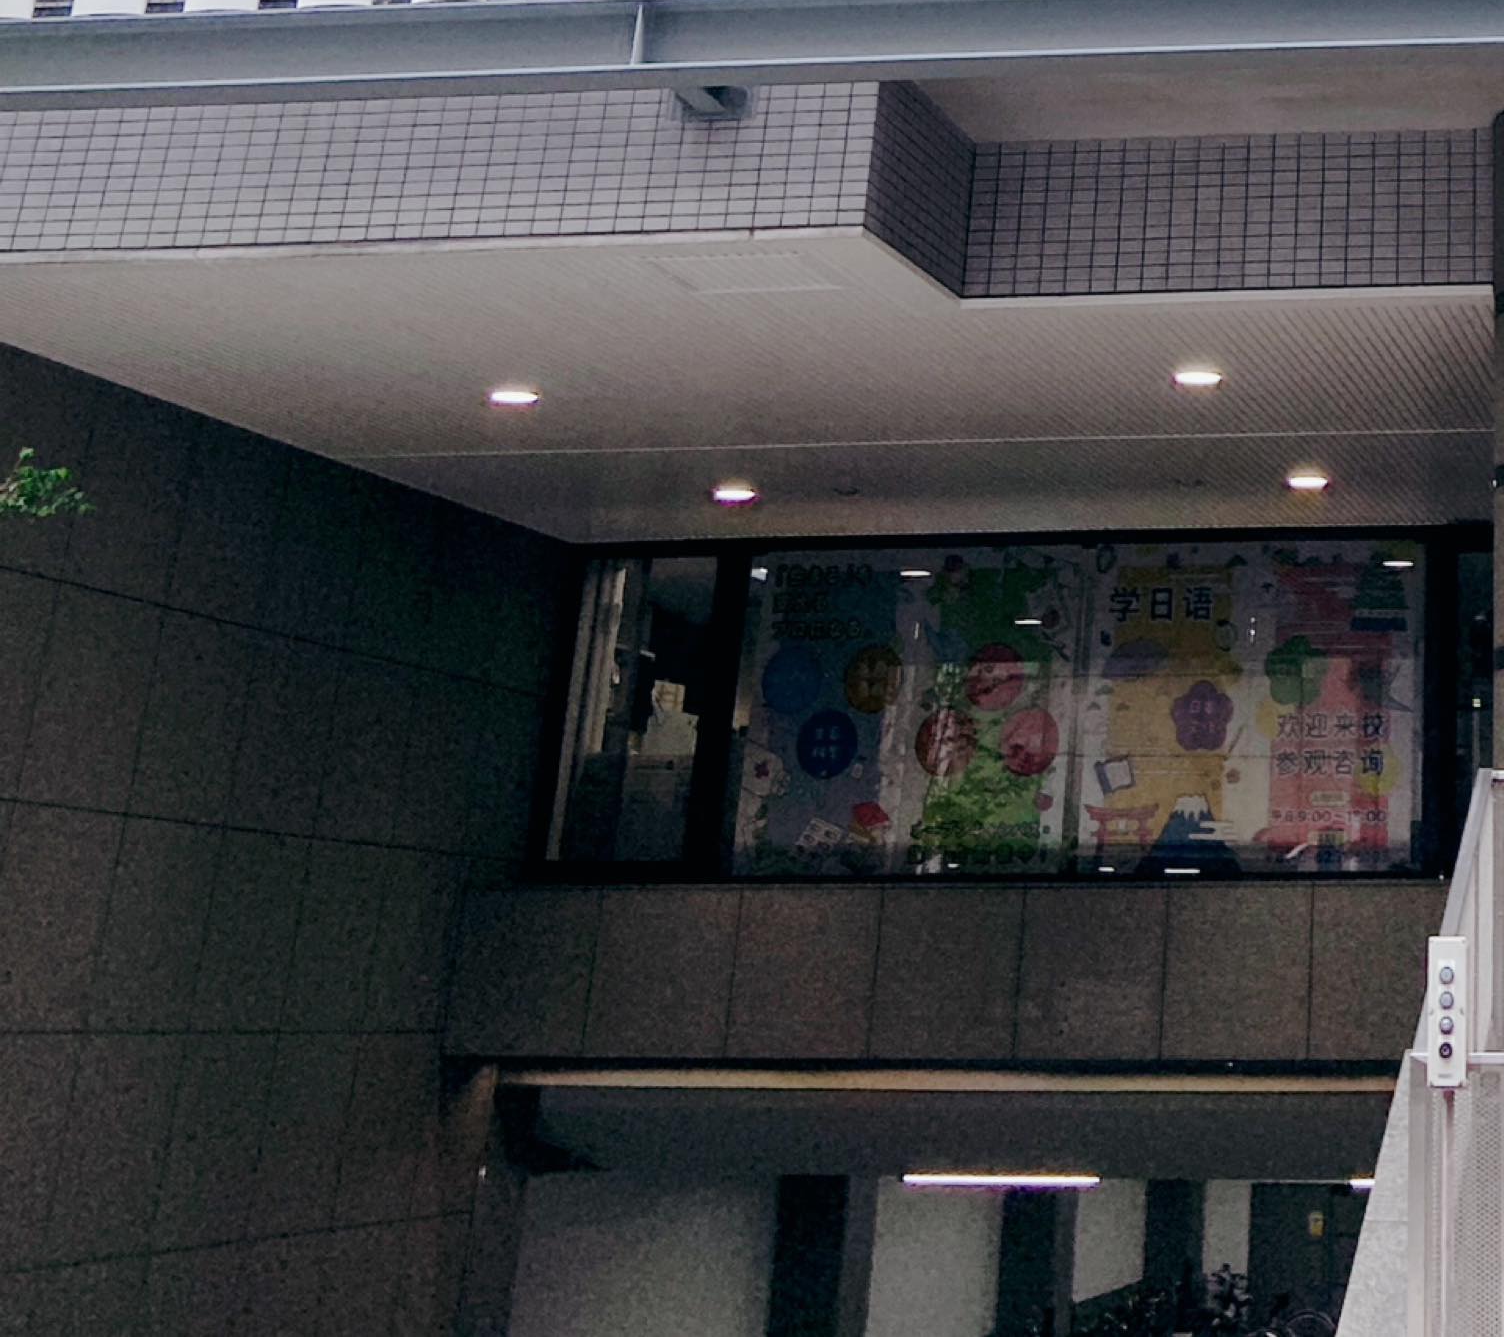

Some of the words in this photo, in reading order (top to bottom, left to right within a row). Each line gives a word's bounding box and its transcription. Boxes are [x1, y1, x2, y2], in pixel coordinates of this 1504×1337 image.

[1109, 586, 1212, 622] 学日语
[1277, 711, 1386, 739] 欢迎来校
[1276, 749, 1385, 776] 参观咨询
